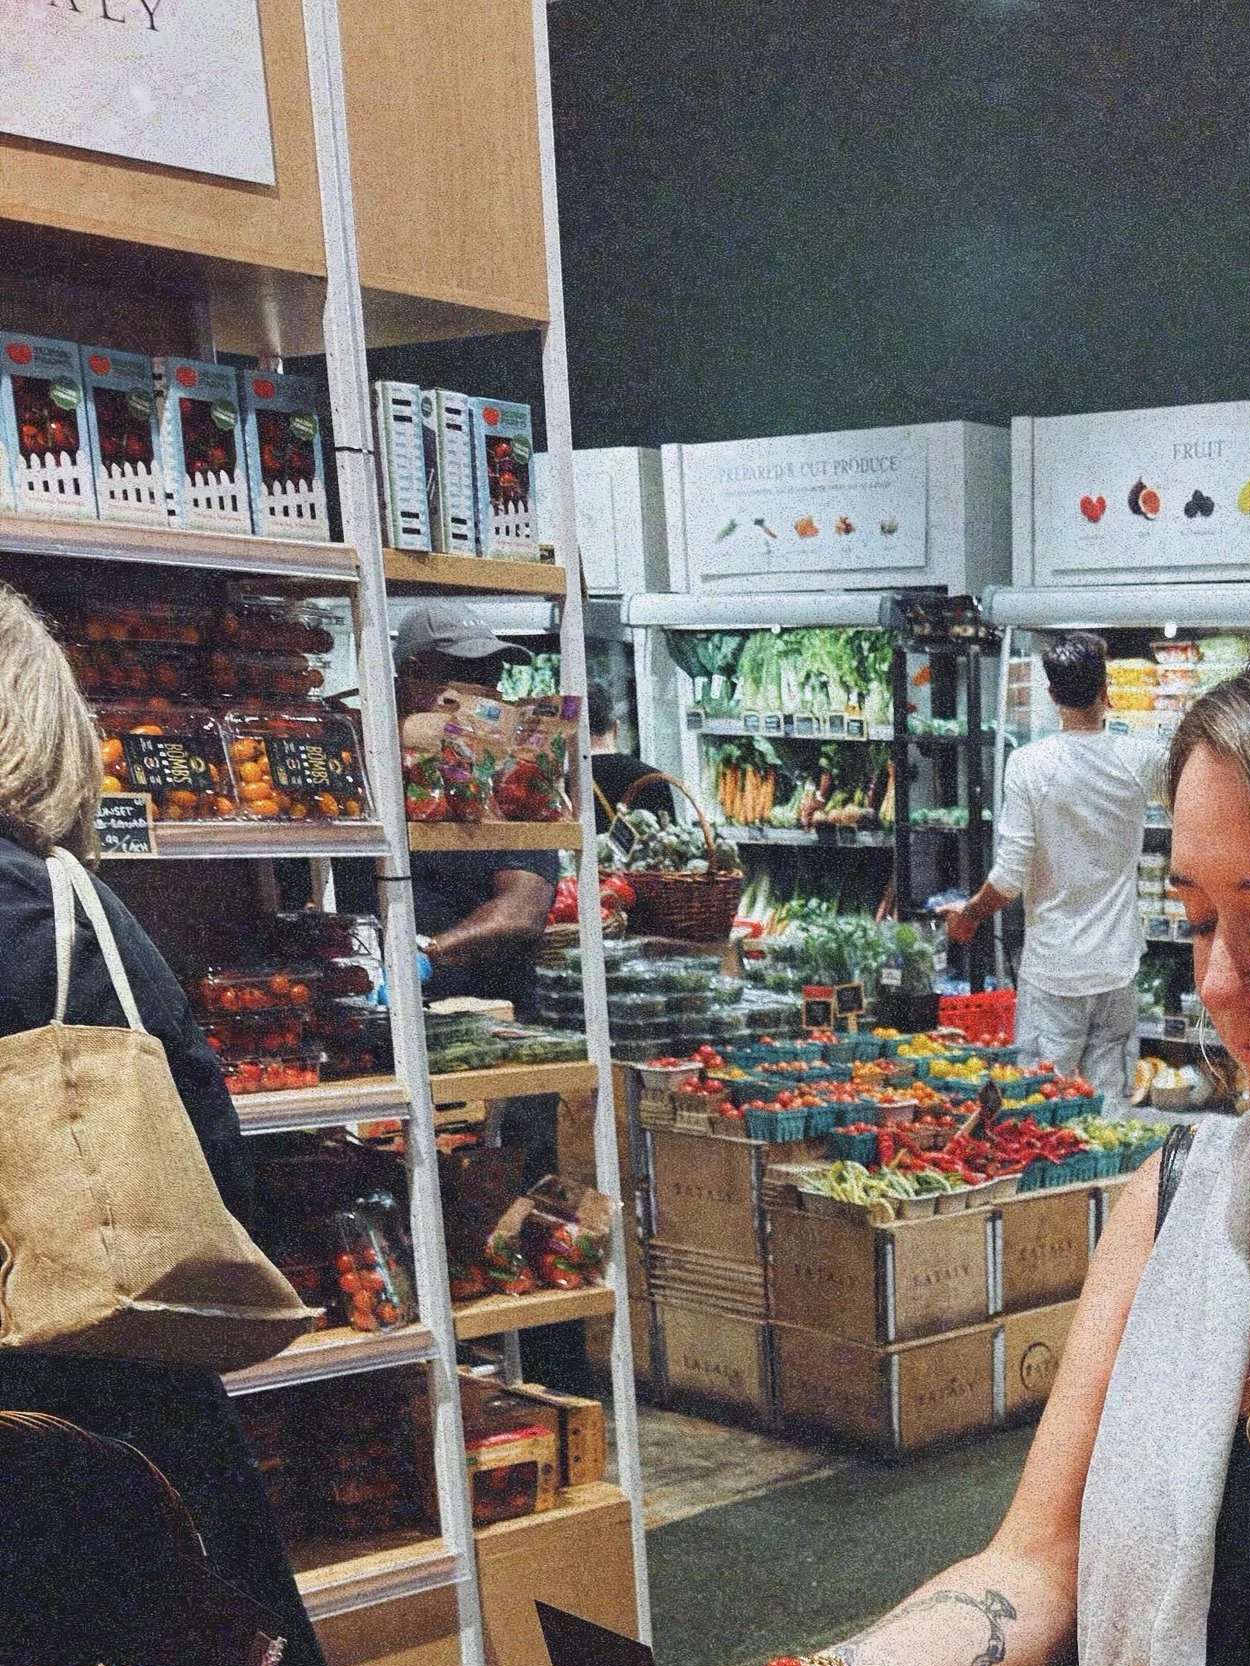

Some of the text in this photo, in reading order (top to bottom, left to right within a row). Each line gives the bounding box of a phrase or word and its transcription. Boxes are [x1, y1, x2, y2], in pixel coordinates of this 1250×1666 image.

[1172, 439, 1226, 461] FRUIT
[800, 460, 829, 478] CUT
[833, 455, 900, 477] PRODUCE
[163, 741, 193, 784] BOMBS
[305, 745, 330, 785] BOMBS
[96, 805, 135, 817] UNSET
